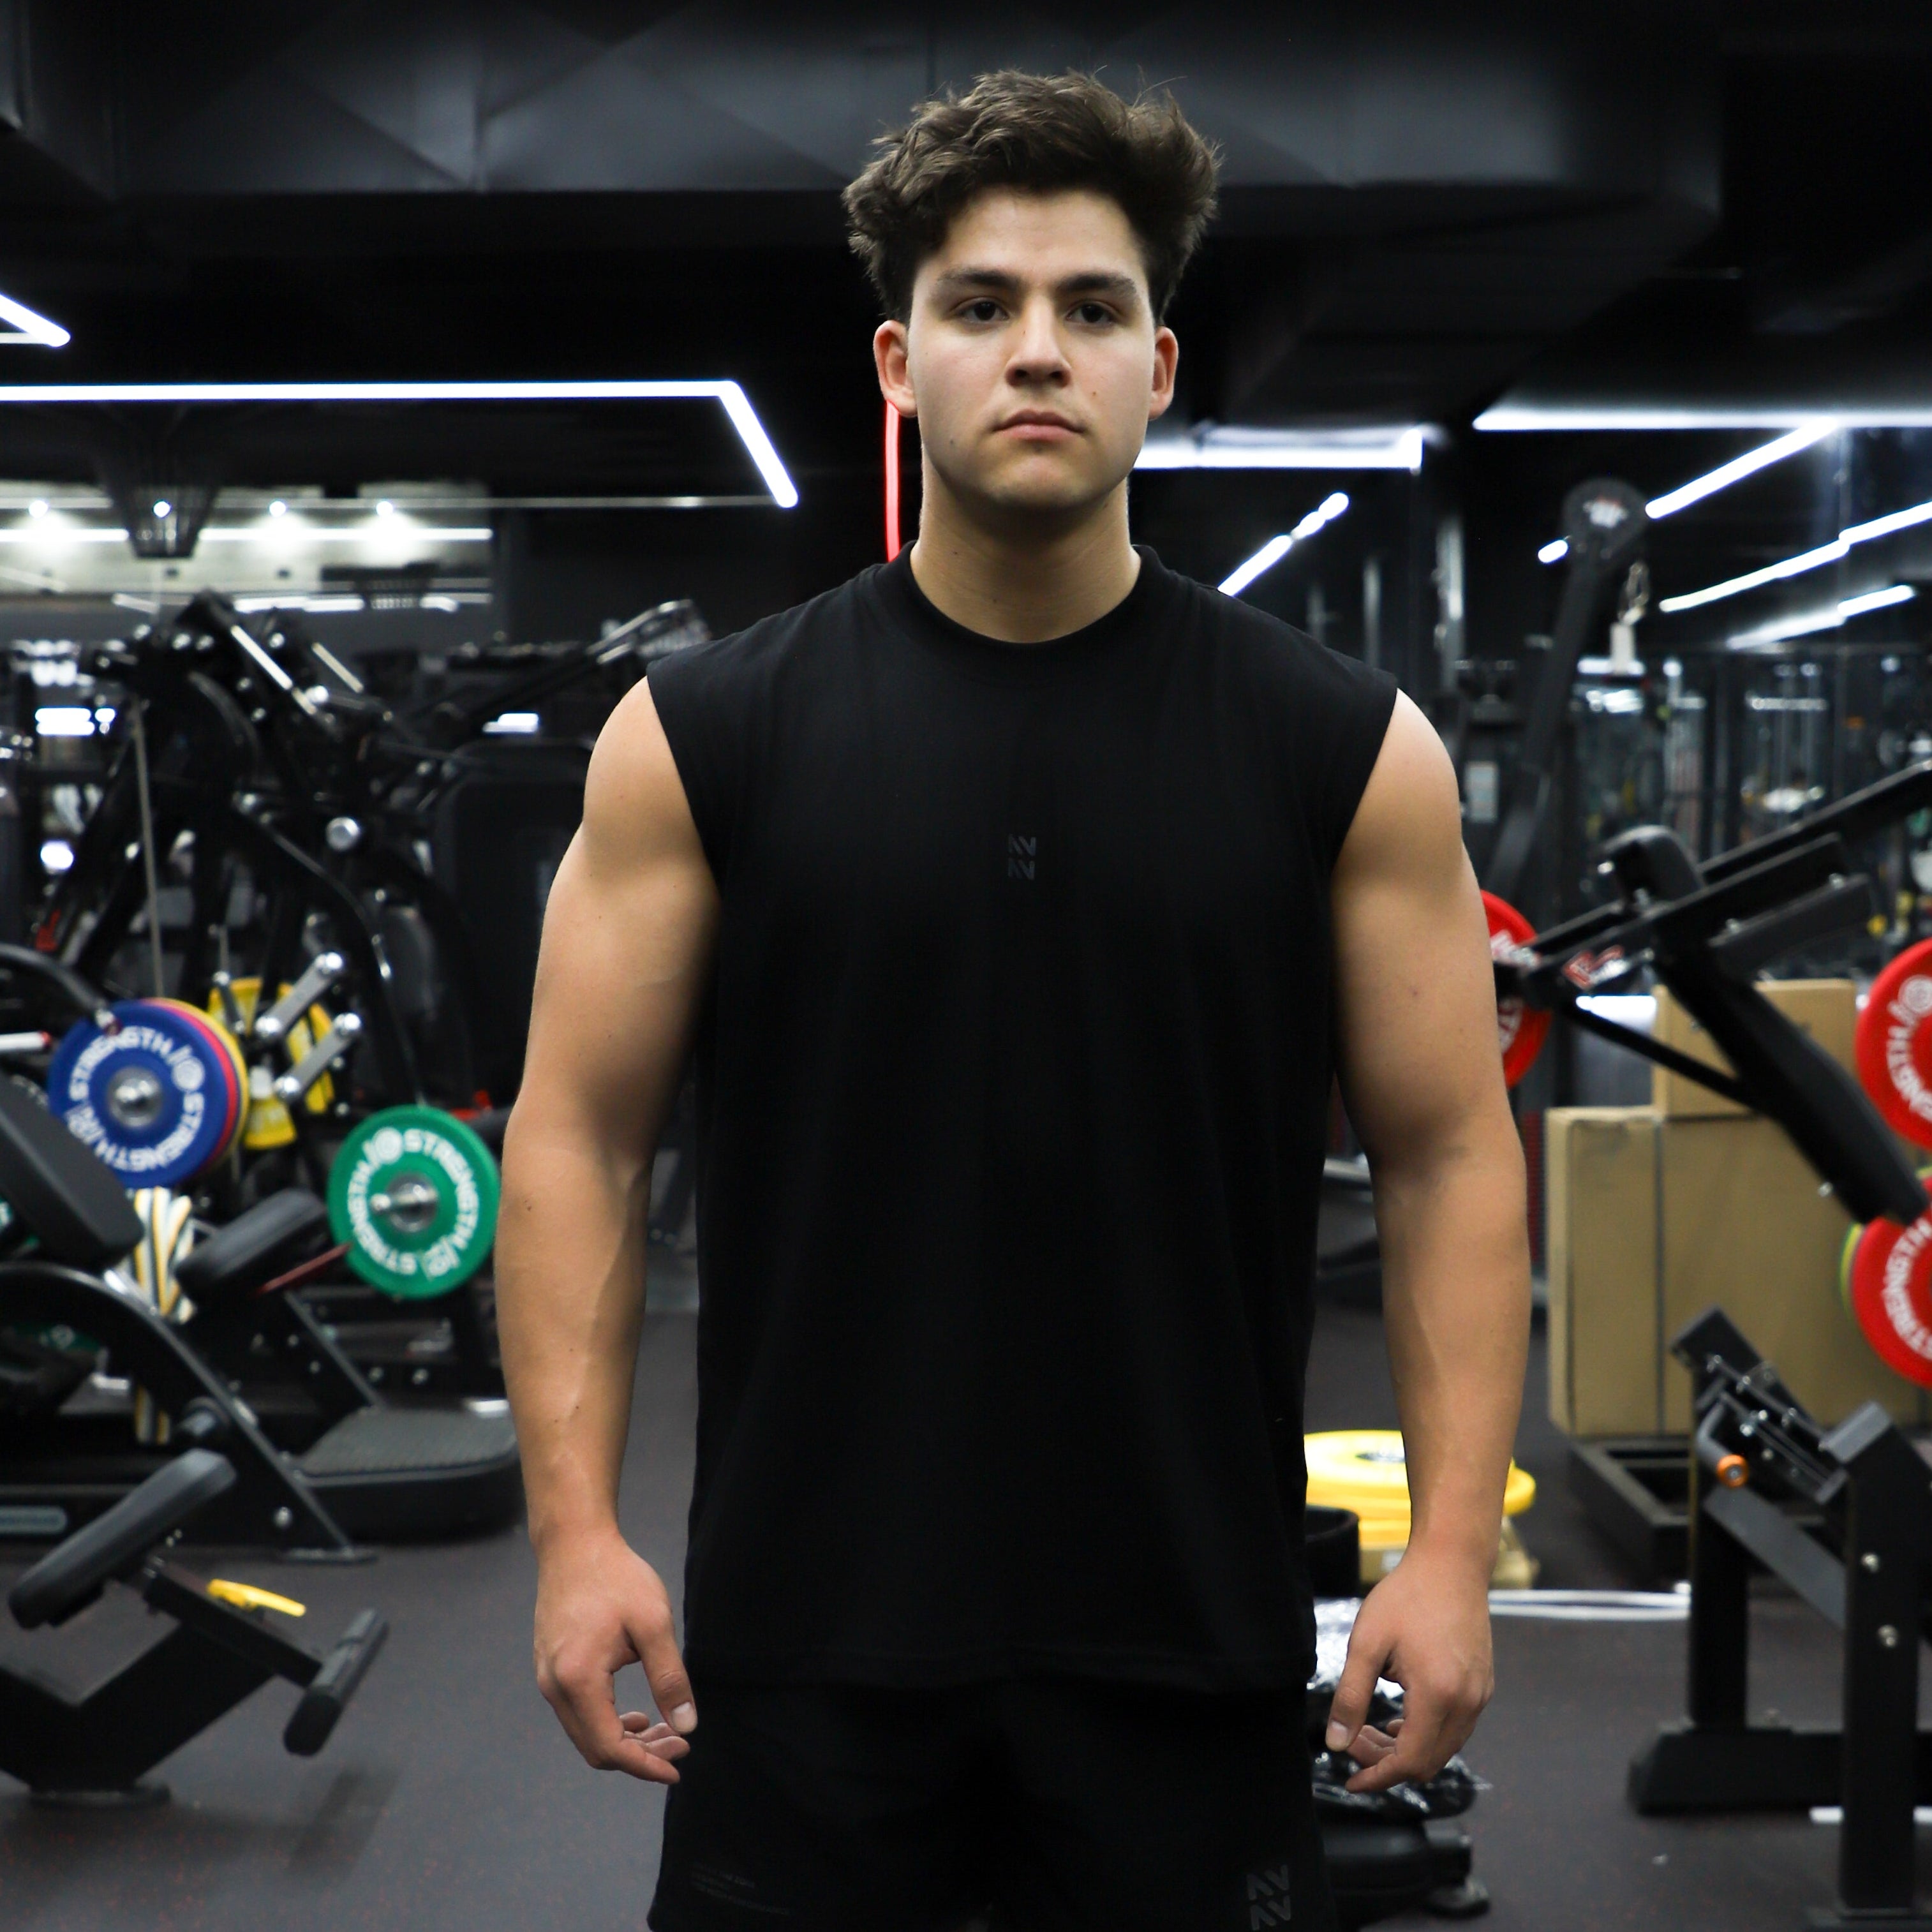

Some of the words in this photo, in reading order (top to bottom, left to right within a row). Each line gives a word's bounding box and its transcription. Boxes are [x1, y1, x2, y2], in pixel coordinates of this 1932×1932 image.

[68, 1025, 174, 1101] STRENGTH
[95, 1091, 205, 1173] STRENGTH
[347, 1159, 418, 1276] STRENGTH
[403, 1128, 479, 1251] STRENGTH
